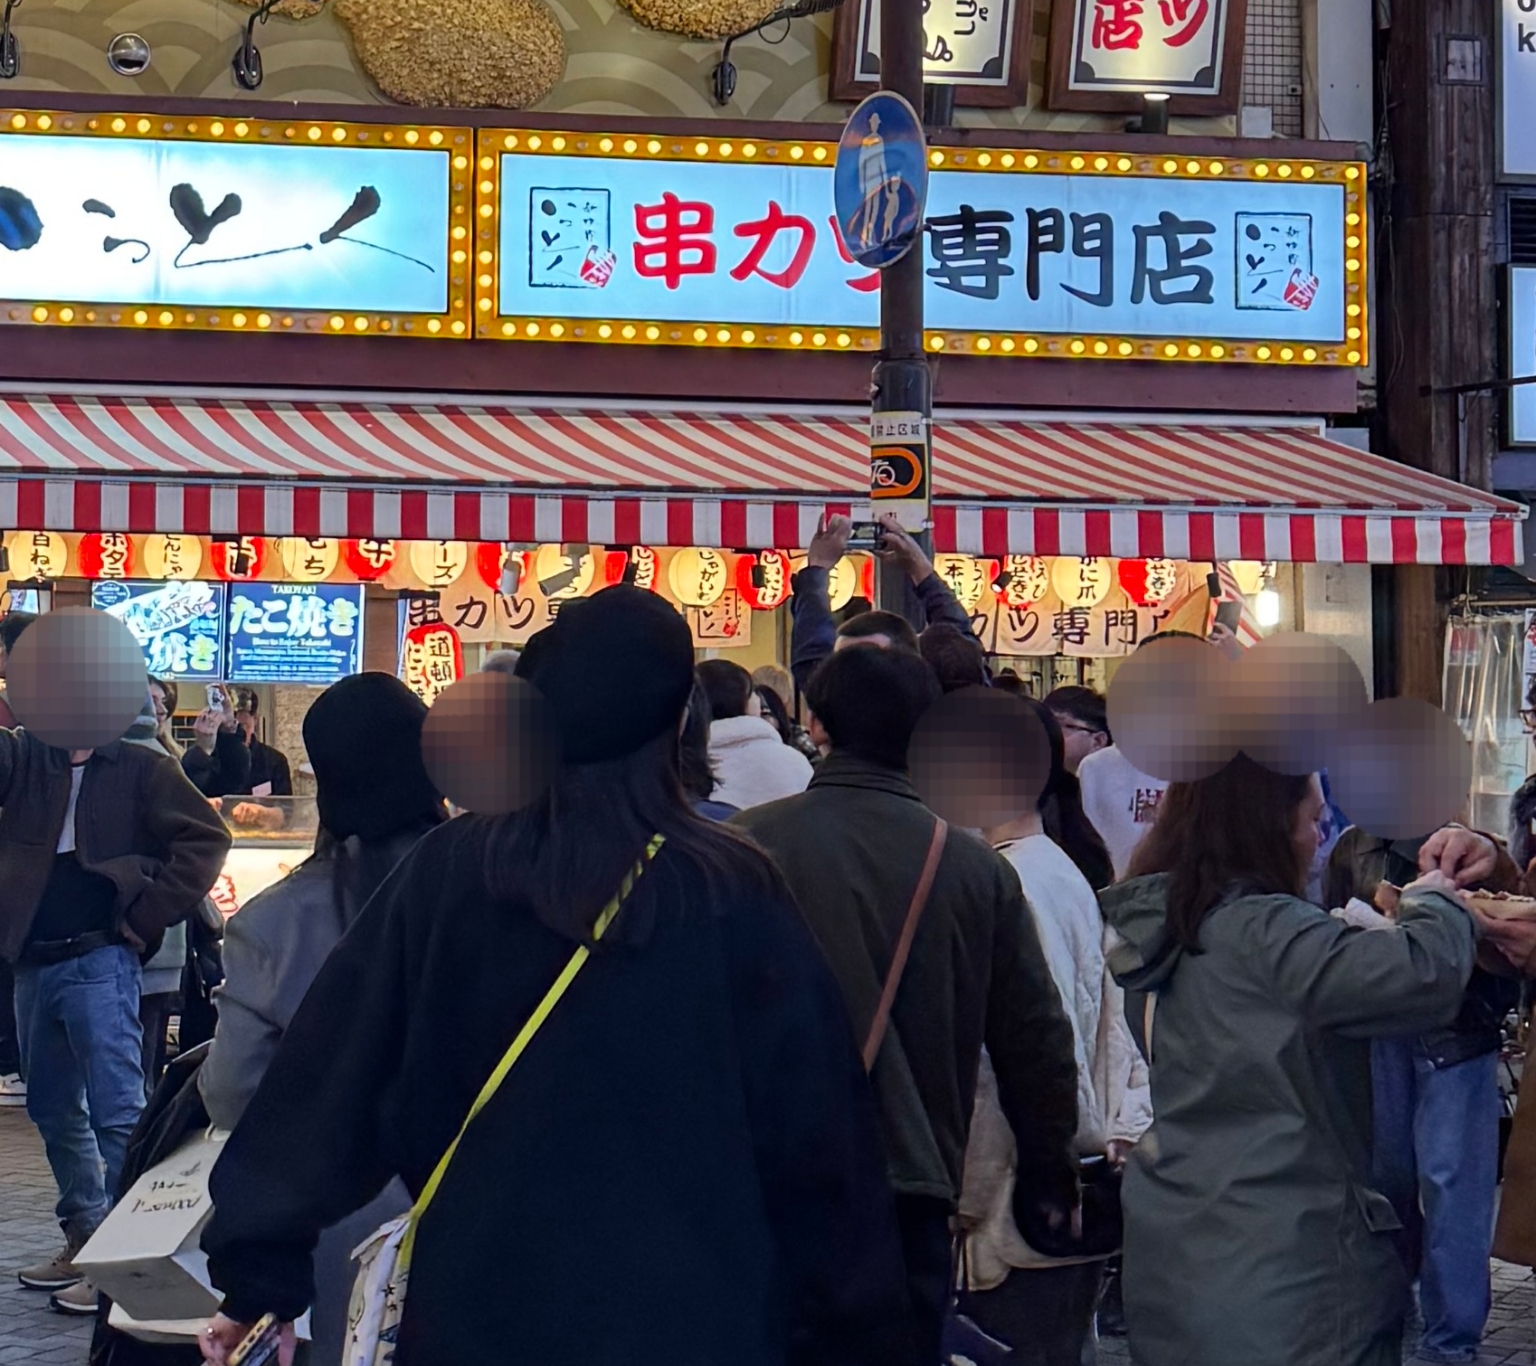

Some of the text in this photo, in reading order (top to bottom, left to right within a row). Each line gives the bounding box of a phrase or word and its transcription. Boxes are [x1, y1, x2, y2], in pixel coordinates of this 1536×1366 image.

[872, 423, 920, 437] 禁止区域
[30, 531, 52, 583] 白ねぎ
[229, 595, 359, 637] たこ焼き
[969, 608, 1171, 646] カツ専門
